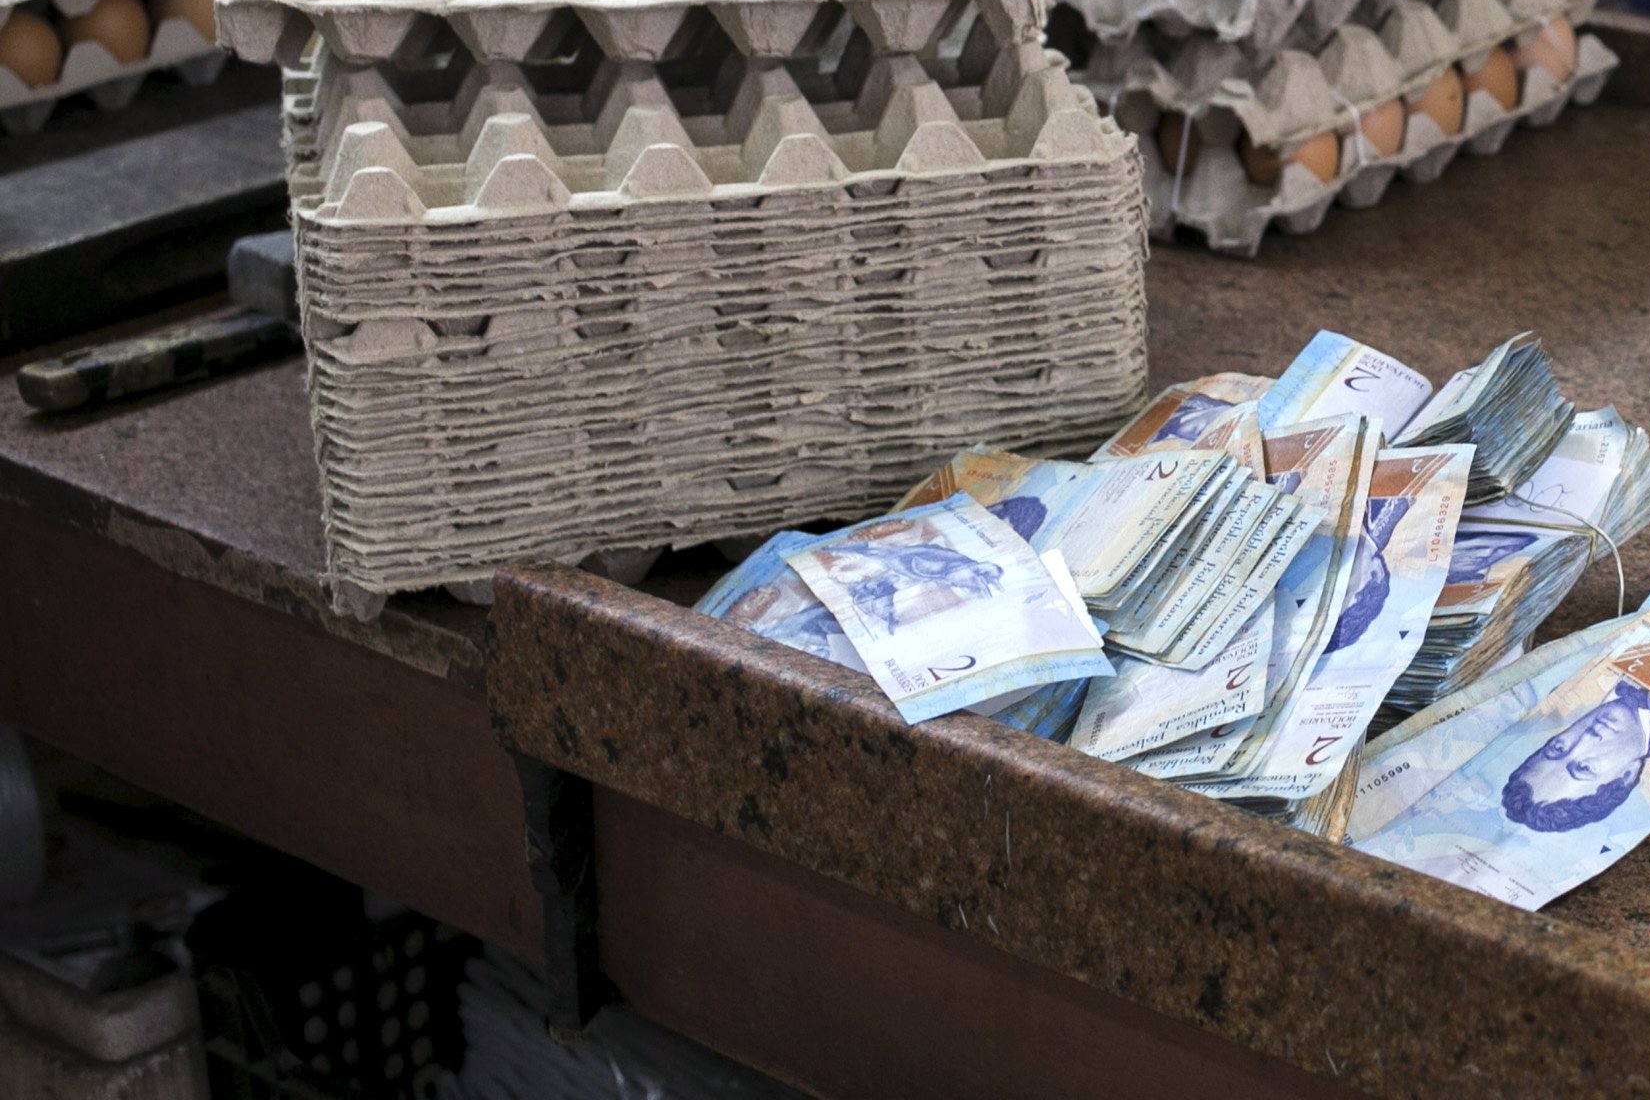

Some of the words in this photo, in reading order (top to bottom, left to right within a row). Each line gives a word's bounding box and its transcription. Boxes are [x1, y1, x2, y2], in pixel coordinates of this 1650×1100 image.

[1343, 366, 1381, 392] 2
[1303, 433, 1316, 449] 2
[1571, 420, 1613, 432] ariana
[1145, 460, 1179, 481] 2
[1411, 458, 1424, 473] 2
[1189, 508, 1236, 569] Venezuela
[1212, 493, 1262, 555] República
[1258, 519, 1306, 580] República
[1159, 560, 1214, 631] Bolivariana
[1199, 586, 1255, 657] Bolivariana
[927, 655, 977, 682] 2
[1226, 661, 1255, 691] 2
[1626, 658, 1644, 673] 2
[1175, 701, 1248, 732] República
[1305, 735, 1344, 766] 2
[1355, 761, 1411, 799] 1105999
